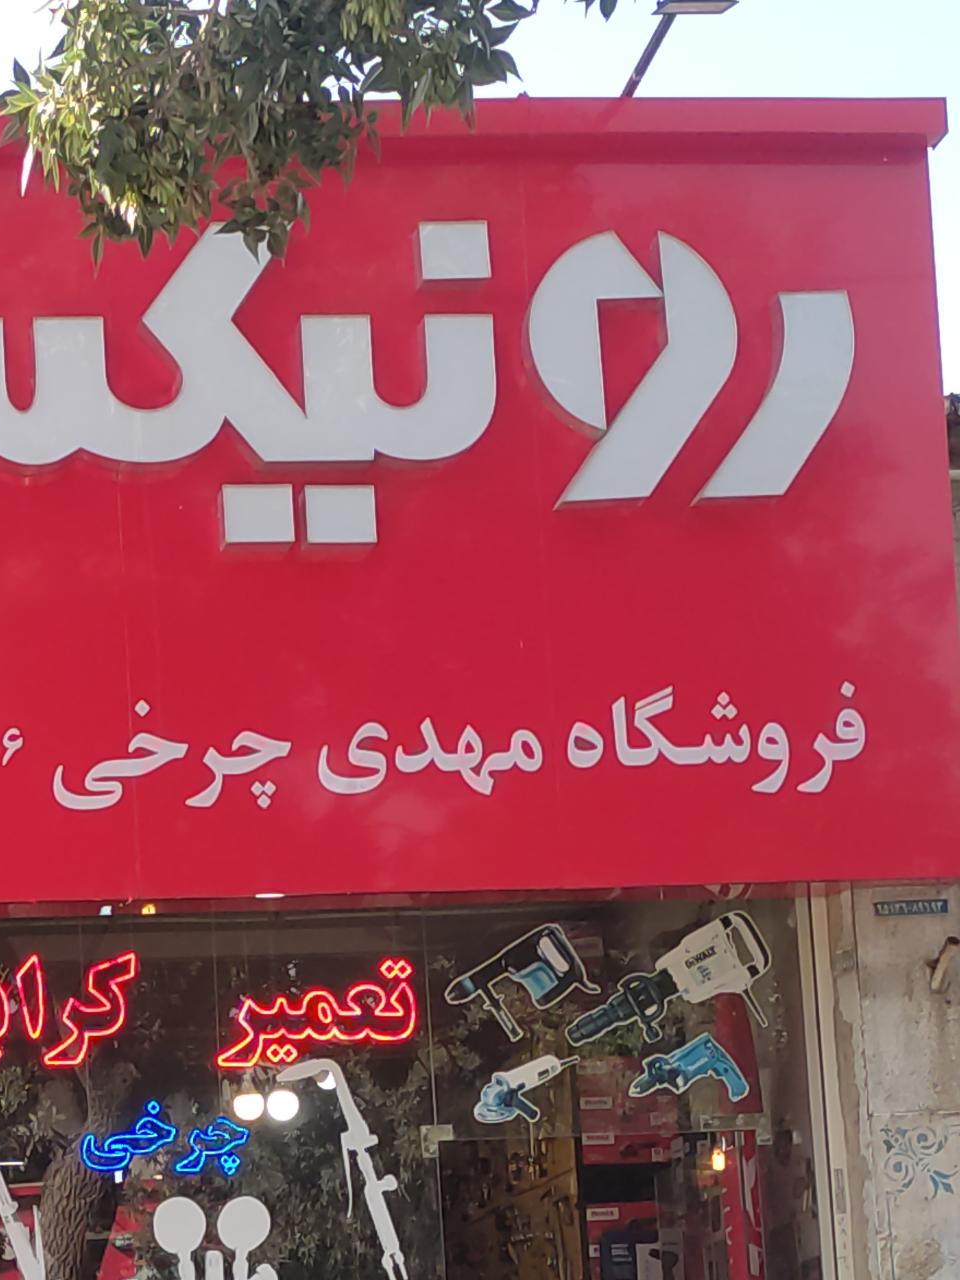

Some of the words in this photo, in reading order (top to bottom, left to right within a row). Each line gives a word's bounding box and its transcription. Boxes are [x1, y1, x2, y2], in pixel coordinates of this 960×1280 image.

[52, 699, 293, 811] چرخی
[318, 717, 543, 796] مهدی
[567, 681, 866, 794] فروشگاه
[217, 958, 417, 1070] تعمیر
[81, 1100, 250, 1177] چرخی
